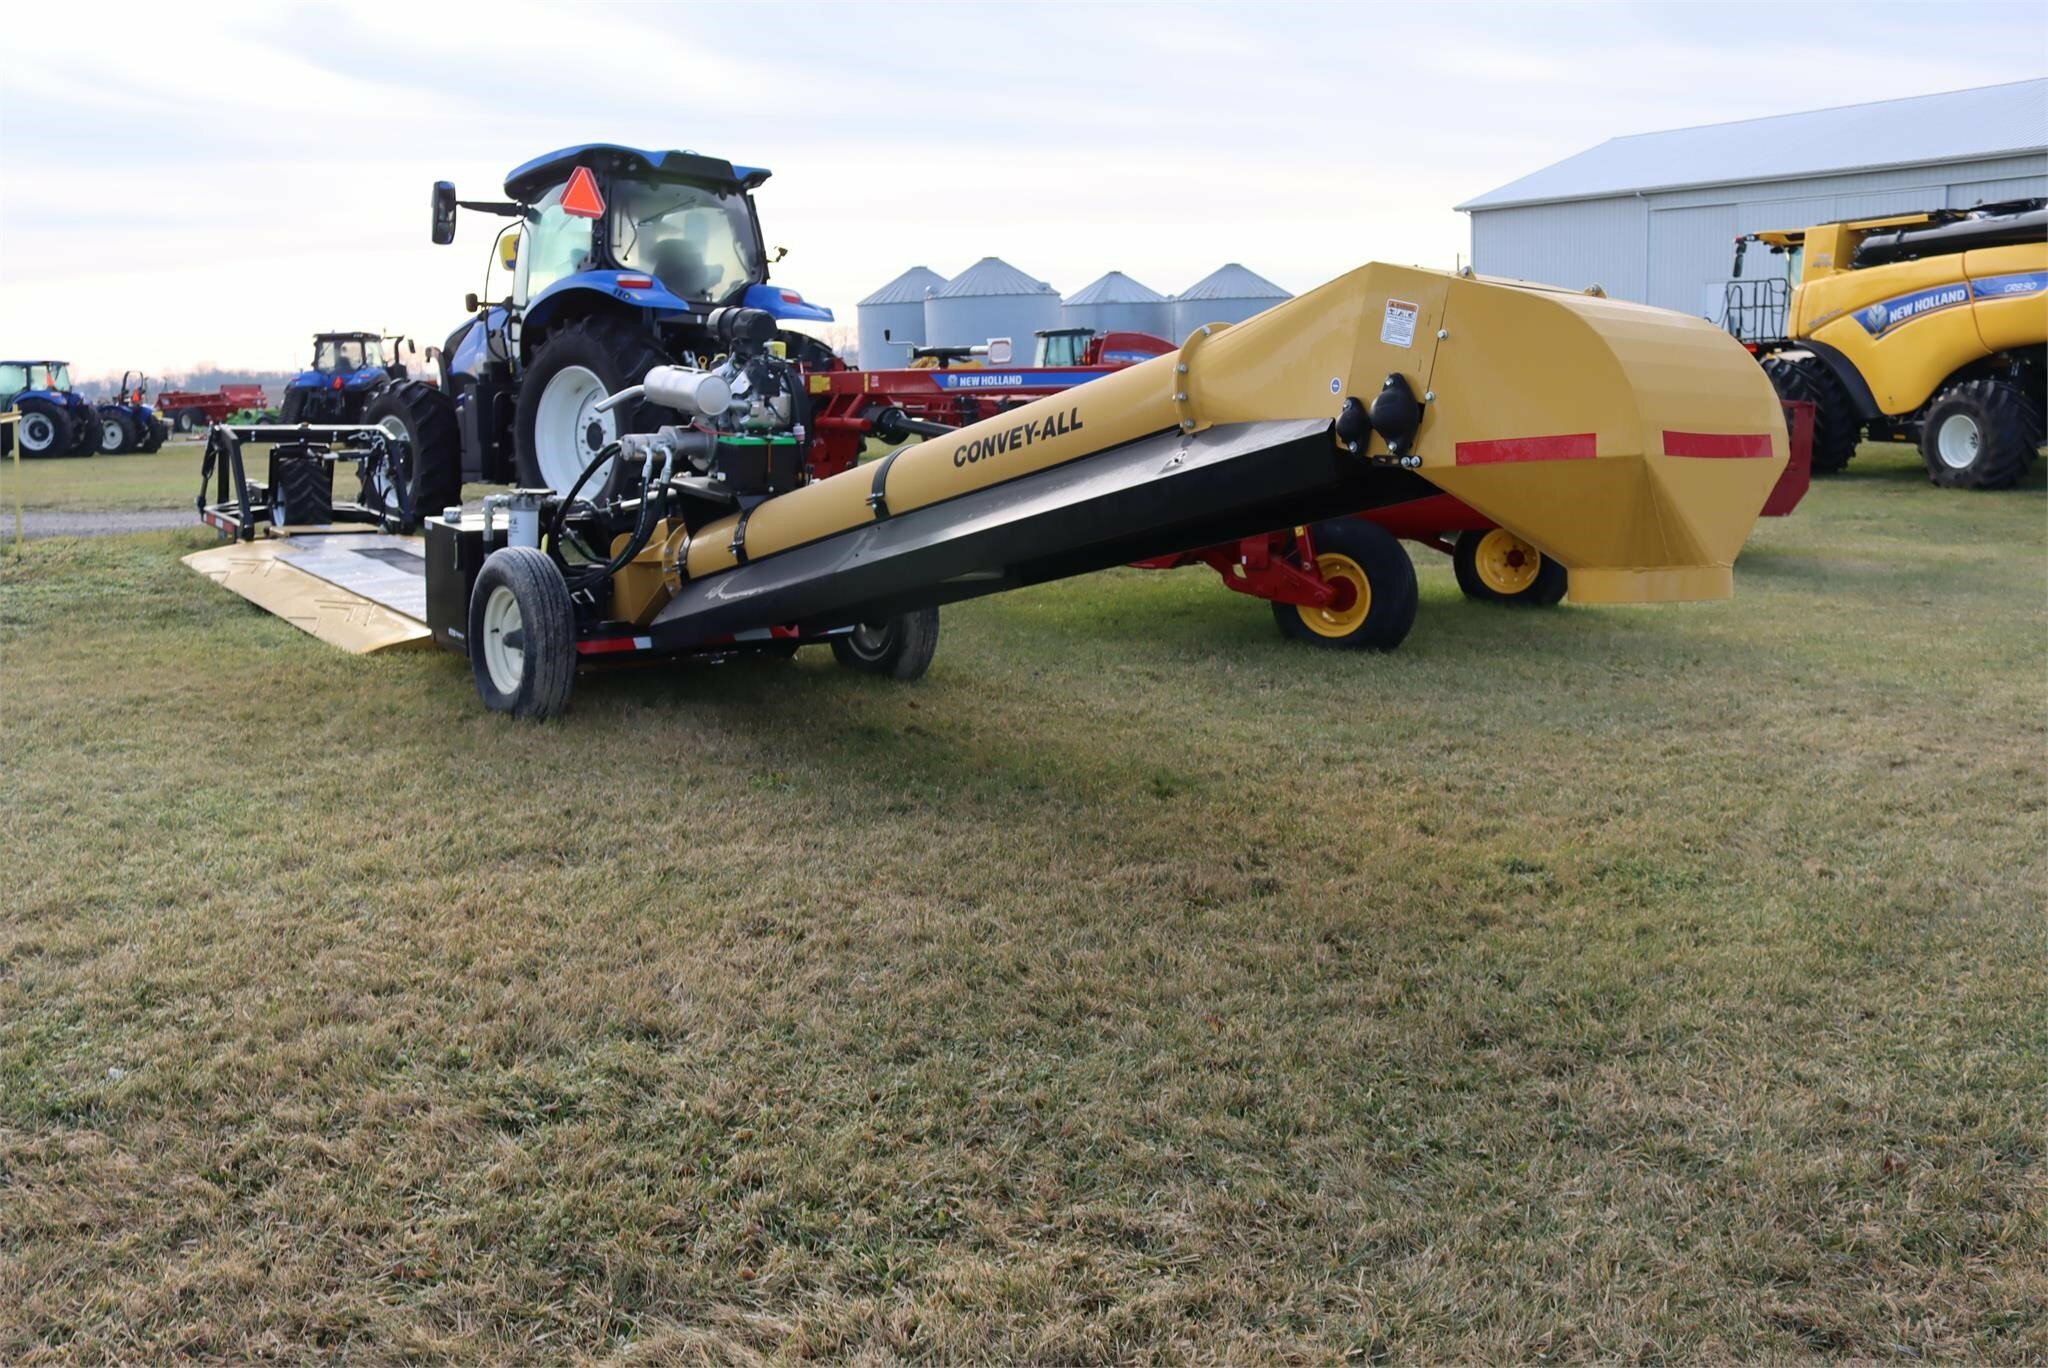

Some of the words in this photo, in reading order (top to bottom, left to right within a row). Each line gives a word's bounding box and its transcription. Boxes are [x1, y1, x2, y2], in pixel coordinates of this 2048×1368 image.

[1889, 303, 1913, 323] NEW
[1914, 289, 1966, 312] HOLLAND
[959, 376, 980, 387] NEW
[981, 375, 1022, 386] HOLLAND
[953, 407, 1083, 468] CONVEY-ALL
